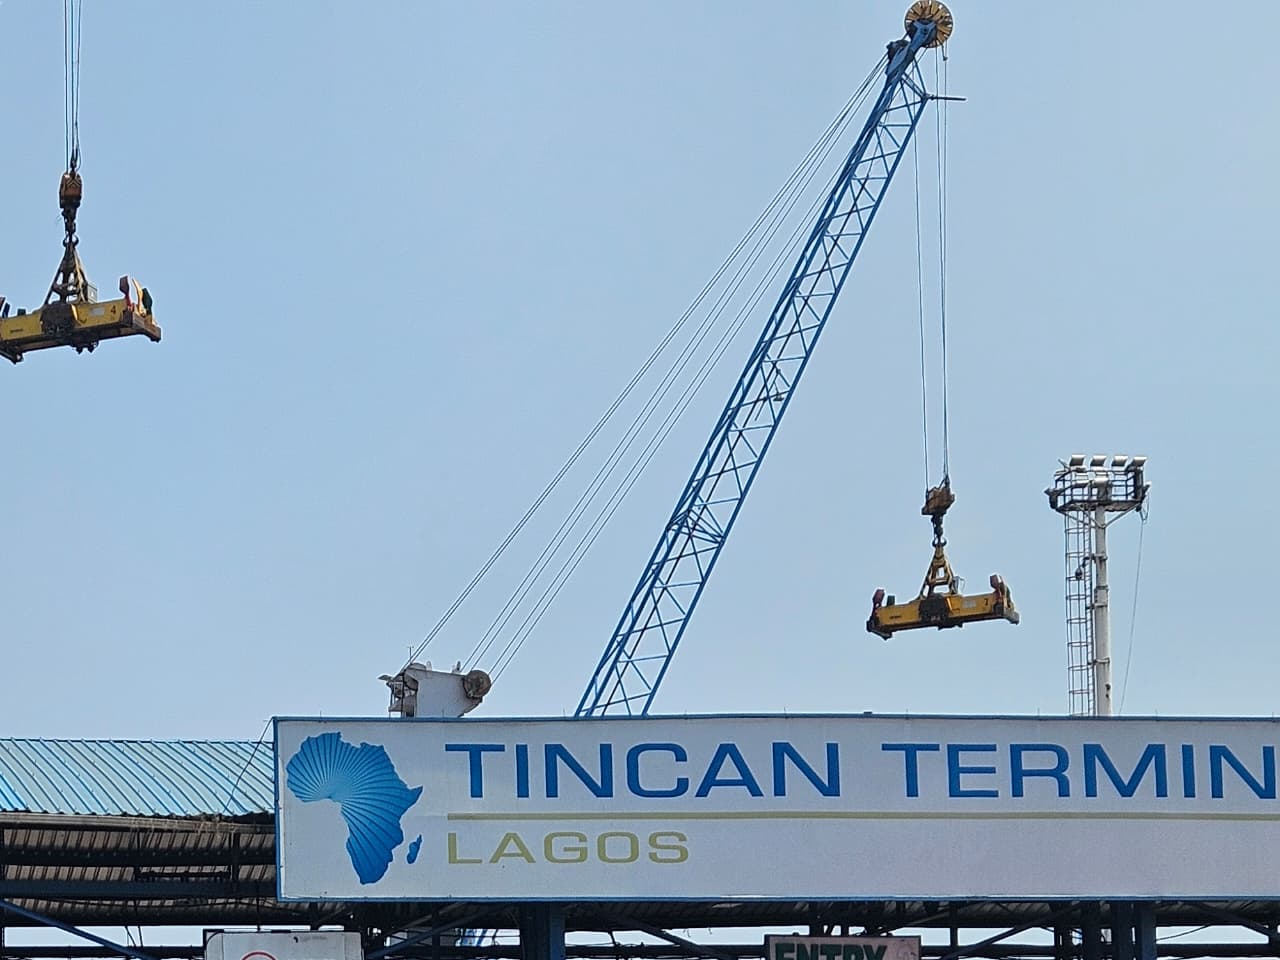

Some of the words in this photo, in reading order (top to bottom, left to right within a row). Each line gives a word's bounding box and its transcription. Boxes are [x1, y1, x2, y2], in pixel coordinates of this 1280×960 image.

[445, 742, 841, 798] TINCAN
[881, 743, 1277, 799] TERMIN
[447, 831, 689, 864] LAGOS
